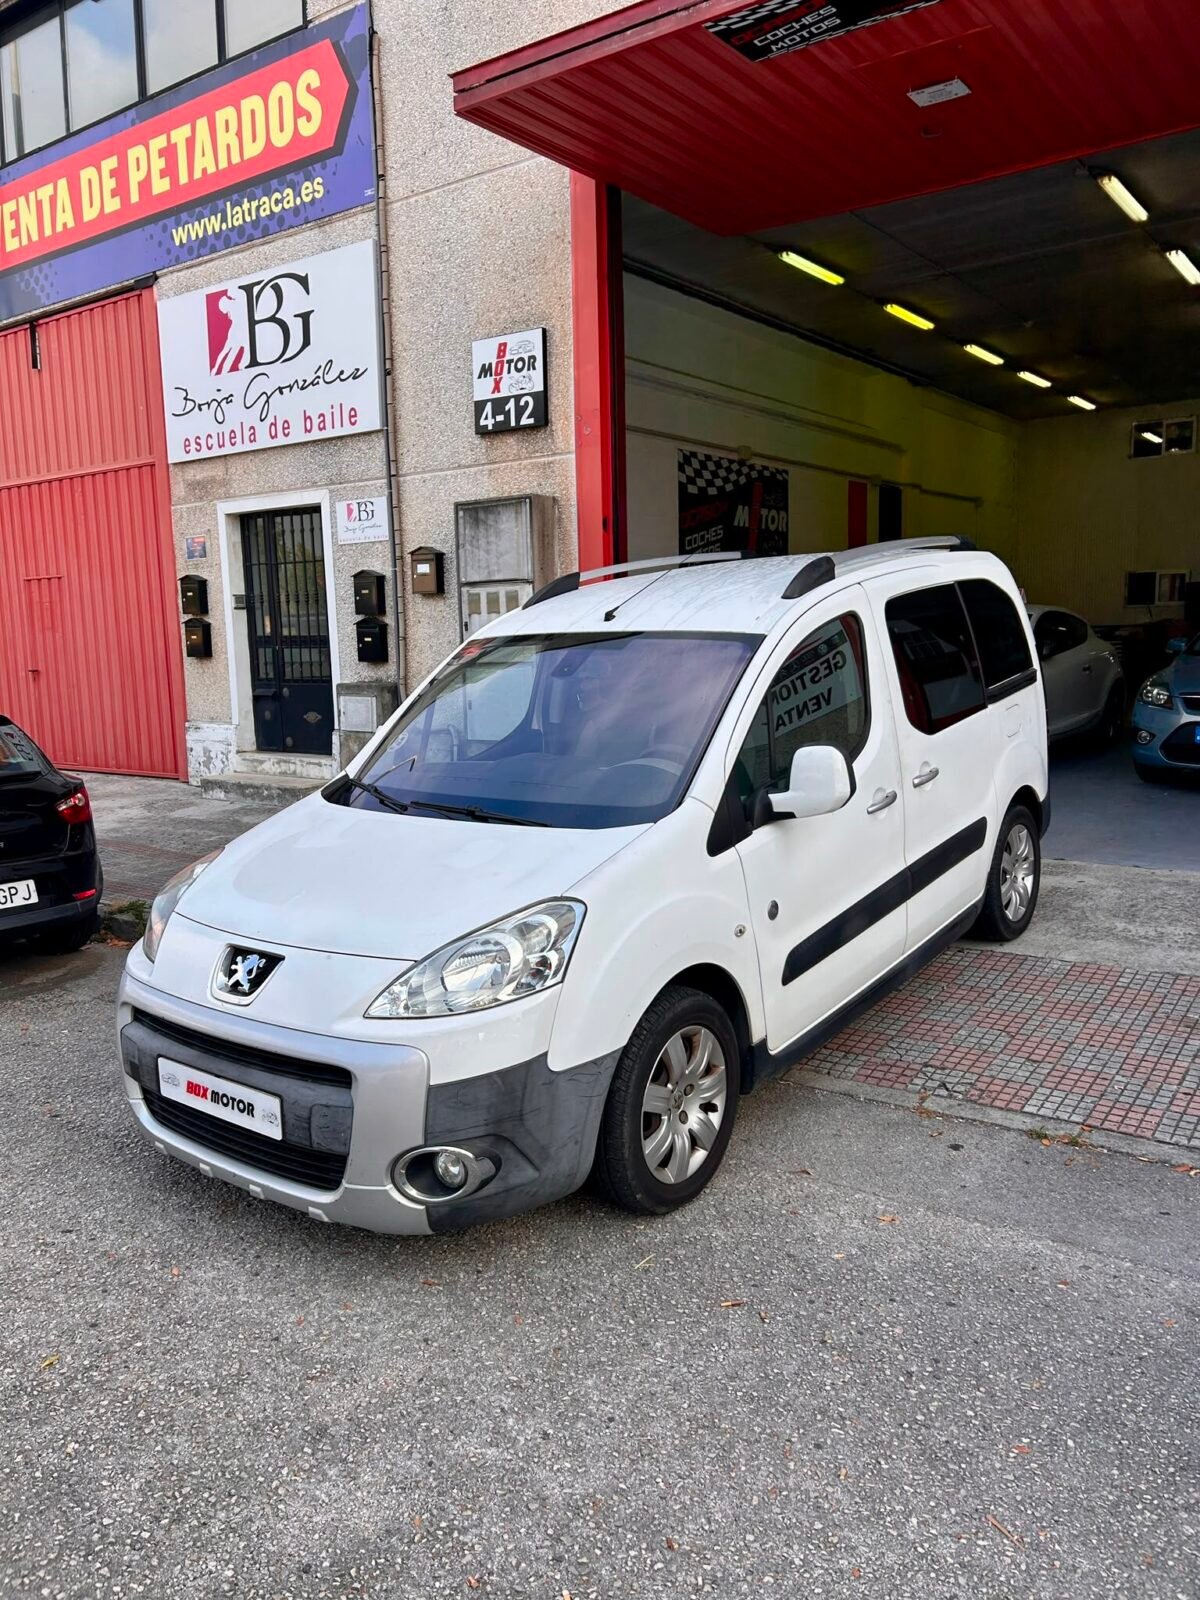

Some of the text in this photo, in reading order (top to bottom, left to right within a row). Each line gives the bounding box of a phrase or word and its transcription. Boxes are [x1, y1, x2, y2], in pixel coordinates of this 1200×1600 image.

[753, 5, 838, 47] COCHES
[770, 17, 842, 52] MOTOS
[0, 68, 323, 253] ENTA DE PETARDOS
[172, 176, 325, 247] www.latraca.es
[238, 272, 315, 370] BG
[477, 354, 537, 380] MOTOR
[172, 359, 369, 425] Borja González
[183, 403, 359, 454] escuela de baile
[479, 395, 535, 430] 4-12
[356, 500, 375, 522] BG
[733, 505, 788, 532] MTOR
[685, 525, 724, 550] COCHES
[0, 883, 32, 905] GPJ
[186, 1080, 255, 1118] BOX MOTOR
